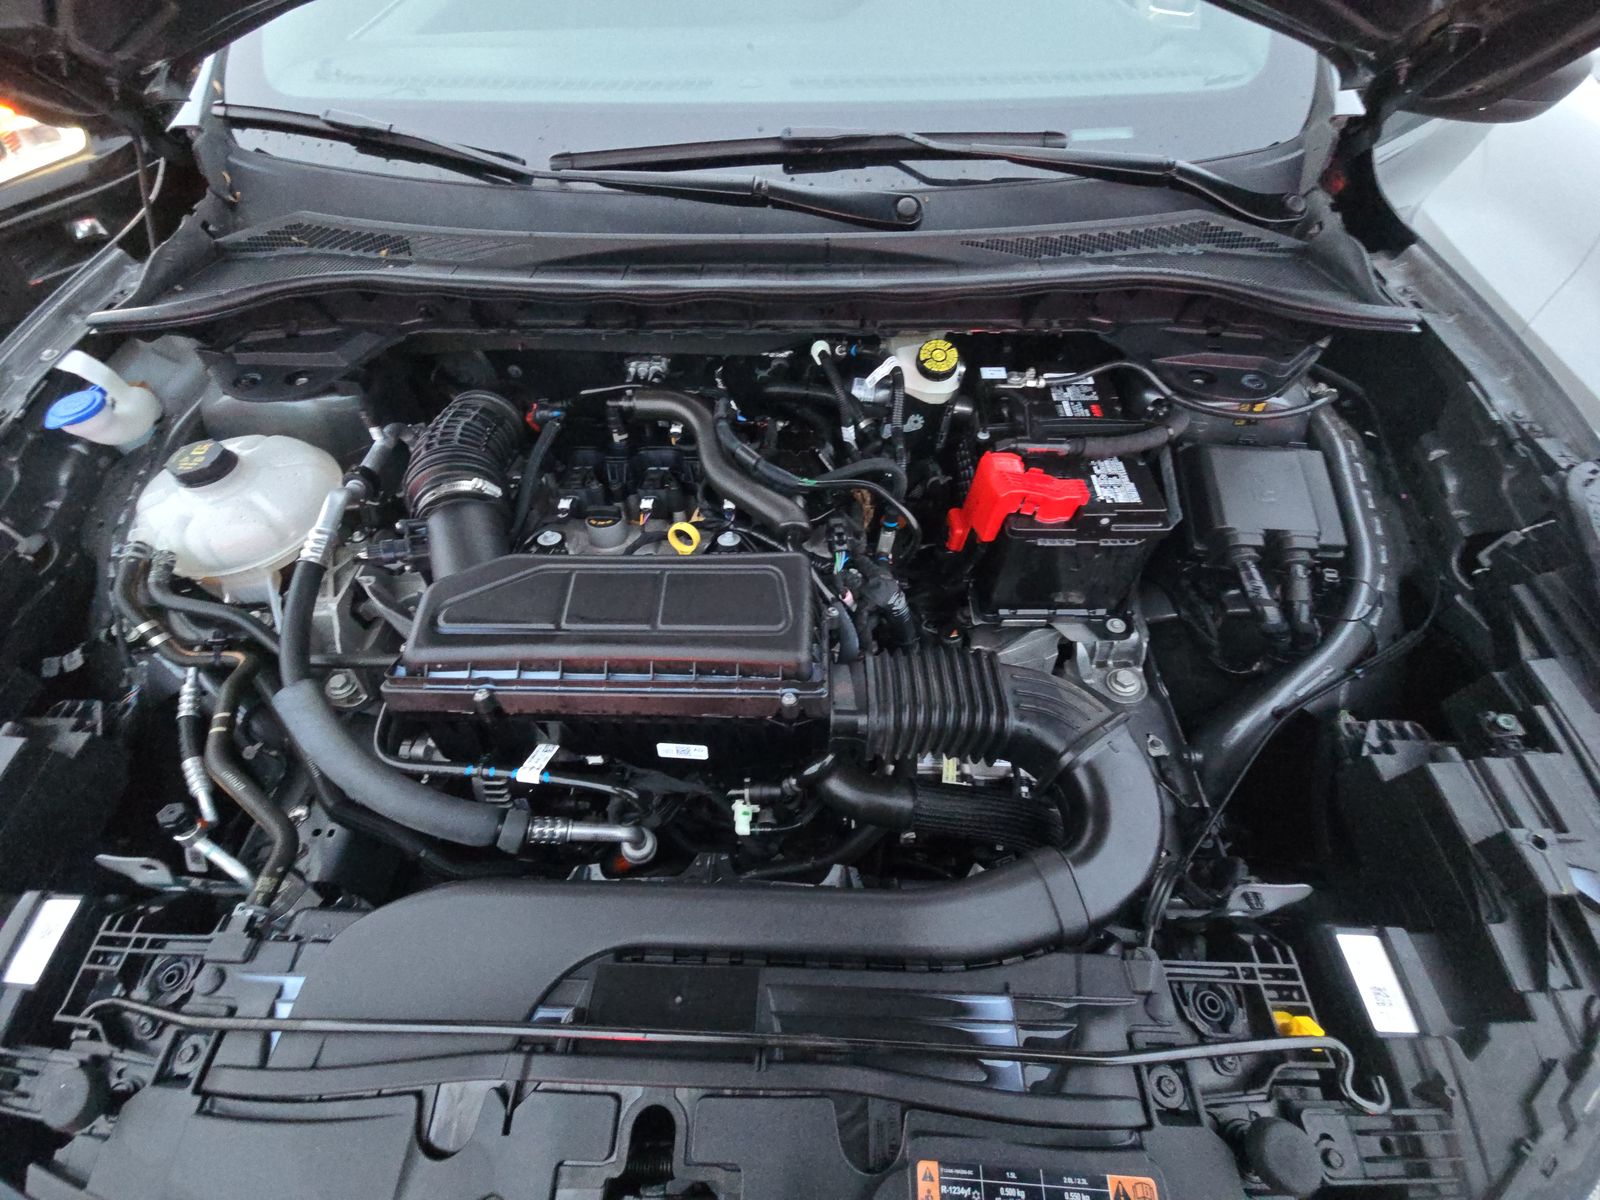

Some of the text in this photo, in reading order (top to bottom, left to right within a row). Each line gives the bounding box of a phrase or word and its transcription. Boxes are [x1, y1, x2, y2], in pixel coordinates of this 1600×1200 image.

[941, 1185, 971, 1198] R-1234yf
[1000, 1187, 1025, 1199] 0.500 kg
